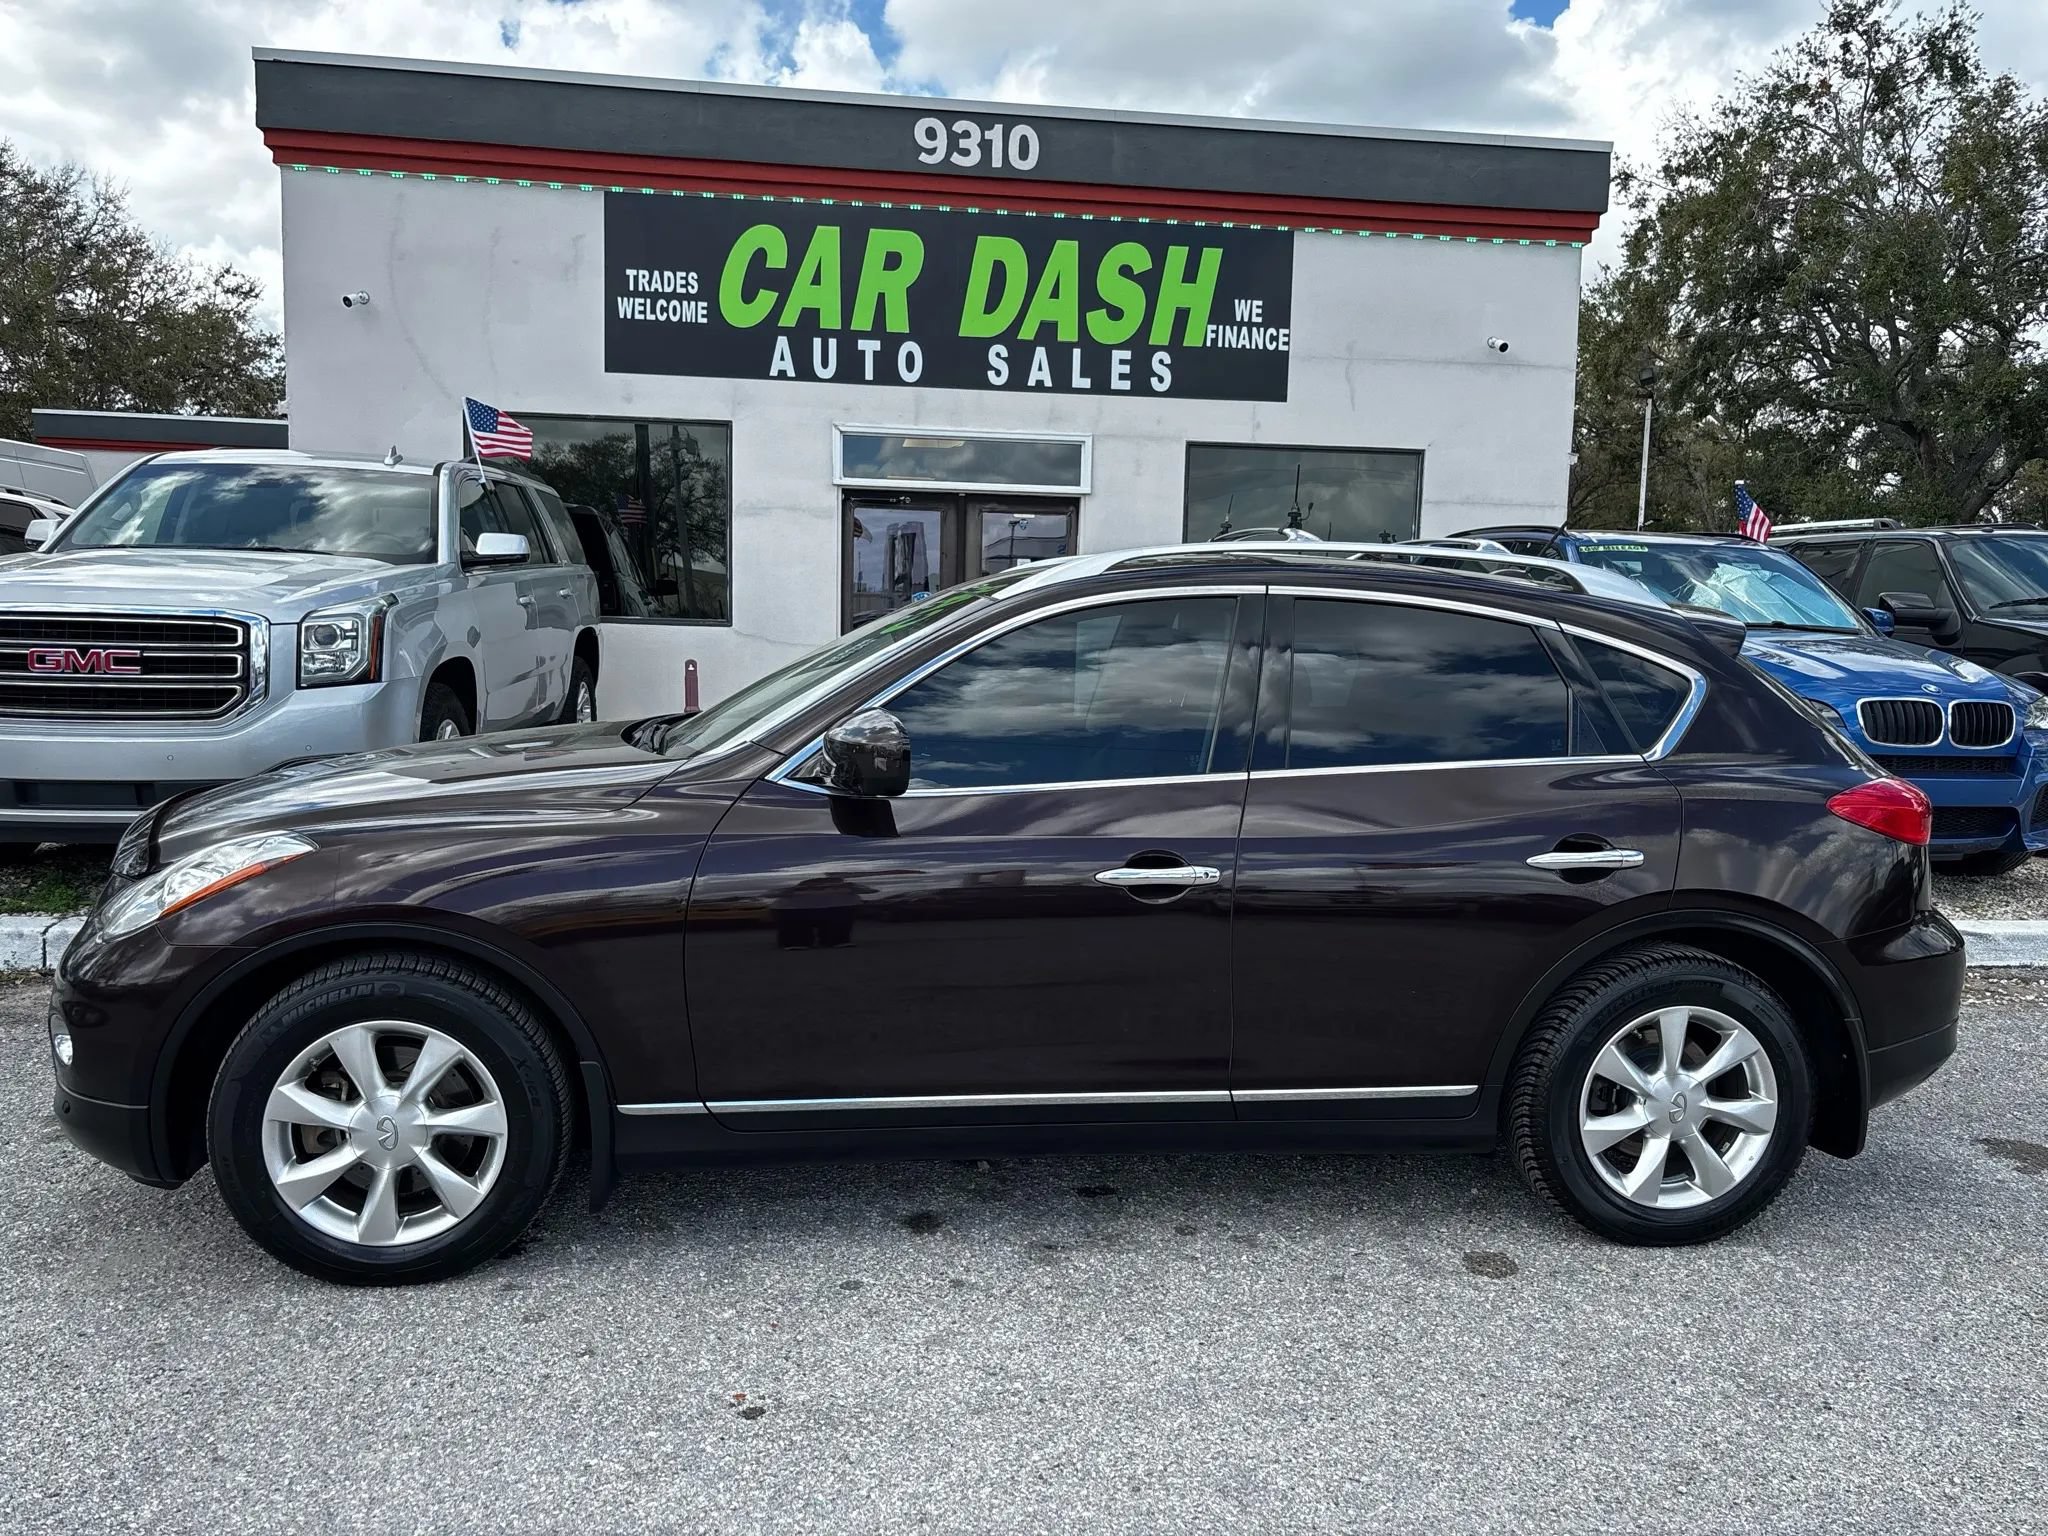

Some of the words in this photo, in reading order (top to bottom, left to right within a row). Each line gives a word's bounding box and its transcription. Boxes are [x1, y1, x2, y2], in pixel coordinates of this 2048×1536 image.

[913, 117, 1040, 171] 9310
[625, 269, 699, 294] TRADES
[719, 223, 925, 333] CAR
[958, 236, 1222, 347] DASH
[617, 297, 708, 323] WELCOME
[1234, 299, 1263, 322] WE
[1206, 324, 1290, 351] FINANCE
[769, 335, 923, 382] AUTO
[986, 344, 1172, 392] SALES
[28, 648, 142, 673] GMC
[281, 983, 375, 1026] MICHELIN
